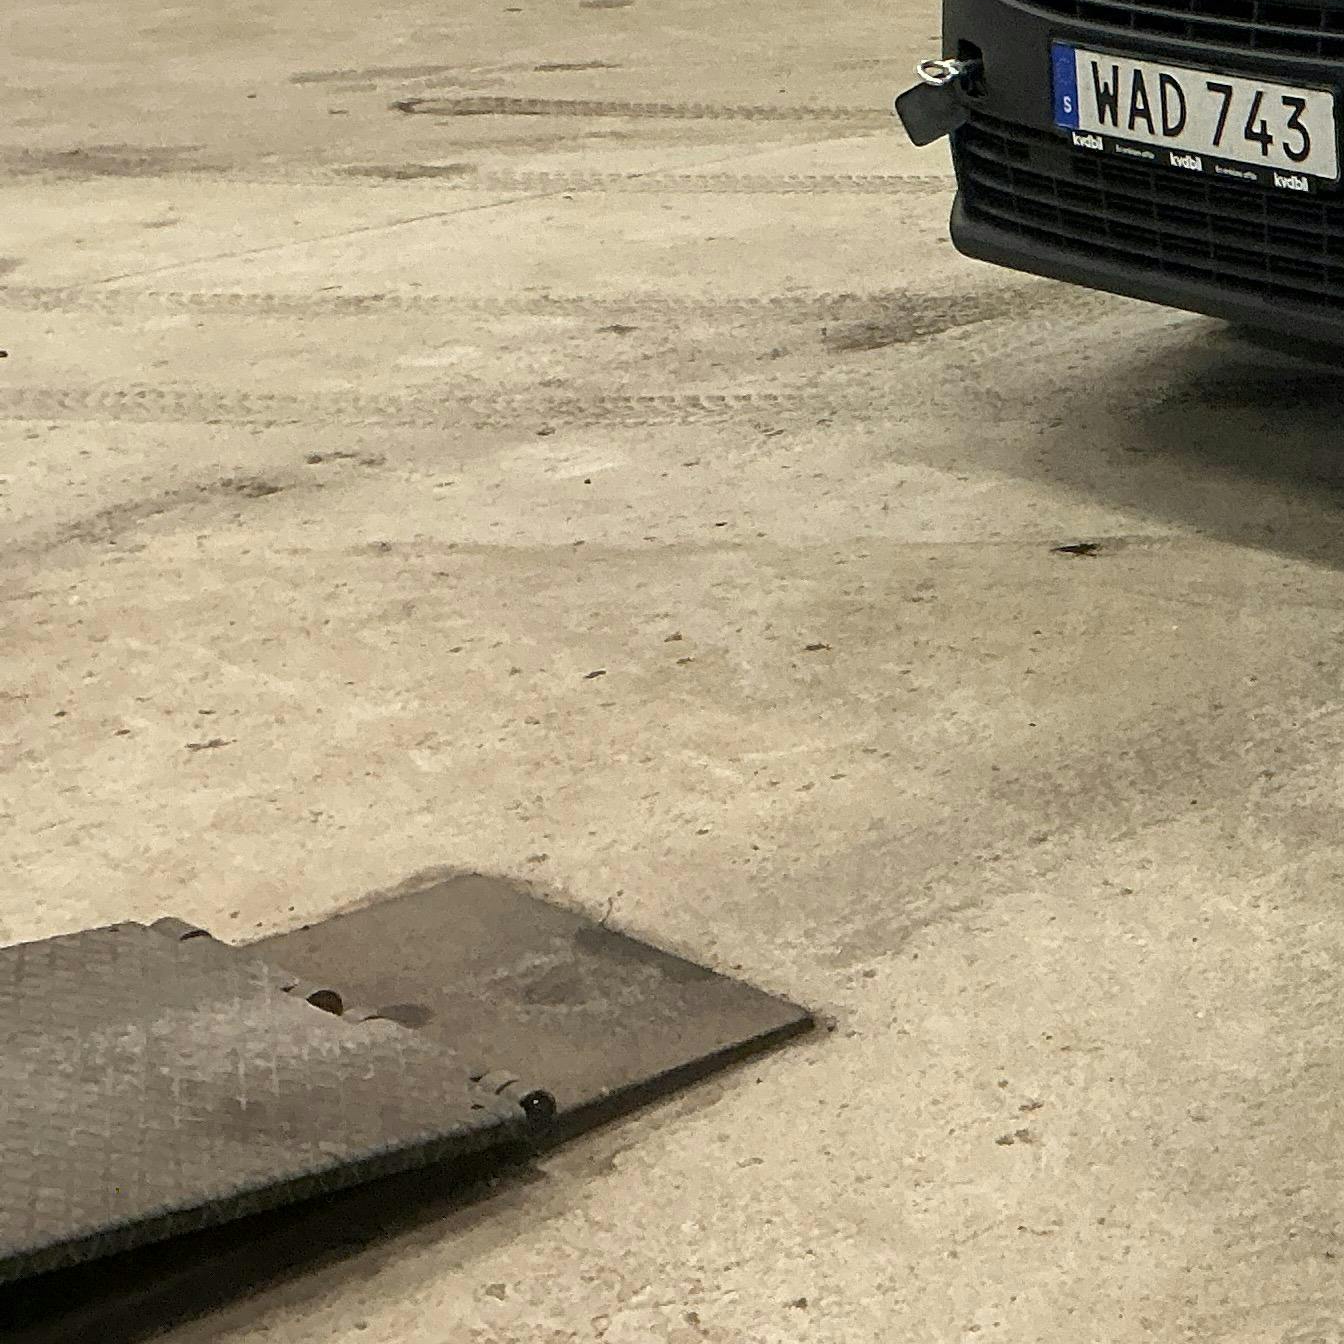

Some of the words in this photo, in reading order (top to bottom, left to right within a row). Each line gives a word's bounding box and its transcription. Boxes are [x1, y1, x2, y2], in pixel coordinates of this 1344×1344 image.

[1062, 95, 1073, 114] S
[1090, 60, 1187, 138] WAD
[1205, 80, 1312, 163] 743
